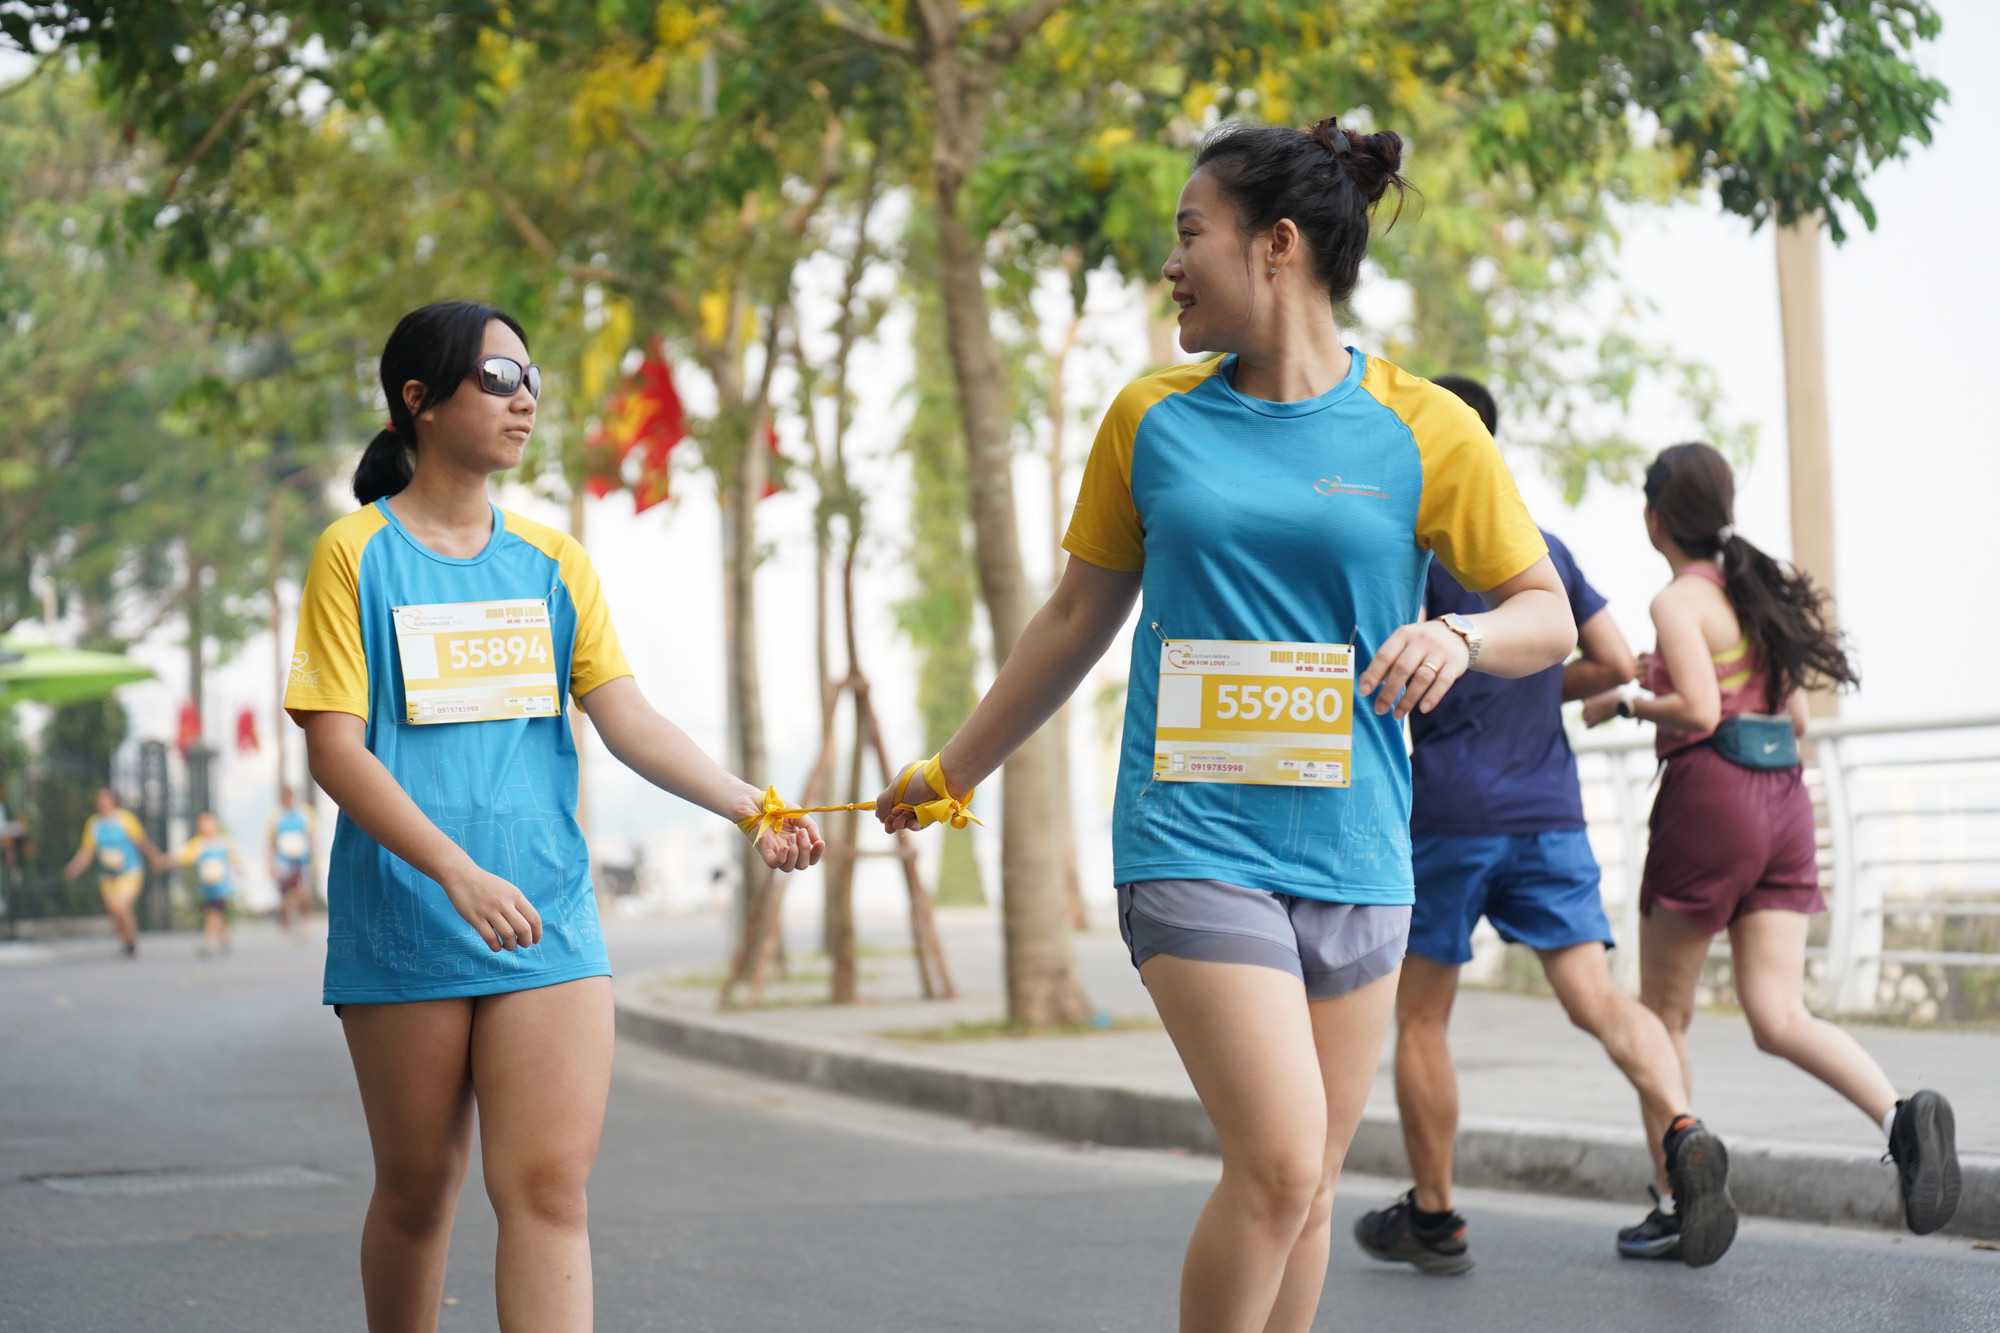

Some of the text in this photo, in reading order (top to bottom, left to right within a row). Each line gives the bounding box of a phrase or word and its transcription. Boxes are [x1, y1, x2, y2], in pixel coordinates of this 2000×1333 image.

[485, 608, 504, 619] RUN
[506, 607, 524, 618] FOR
[449, 635, 548, 669] 55894
[1270, 650, 1348, 666] RUN FOR LOVE
[437, 706, 480, 714] 0919785998
[1216, 684, 1343, 723] 55980
[1190, 764, 1244, 772] 0919785998
